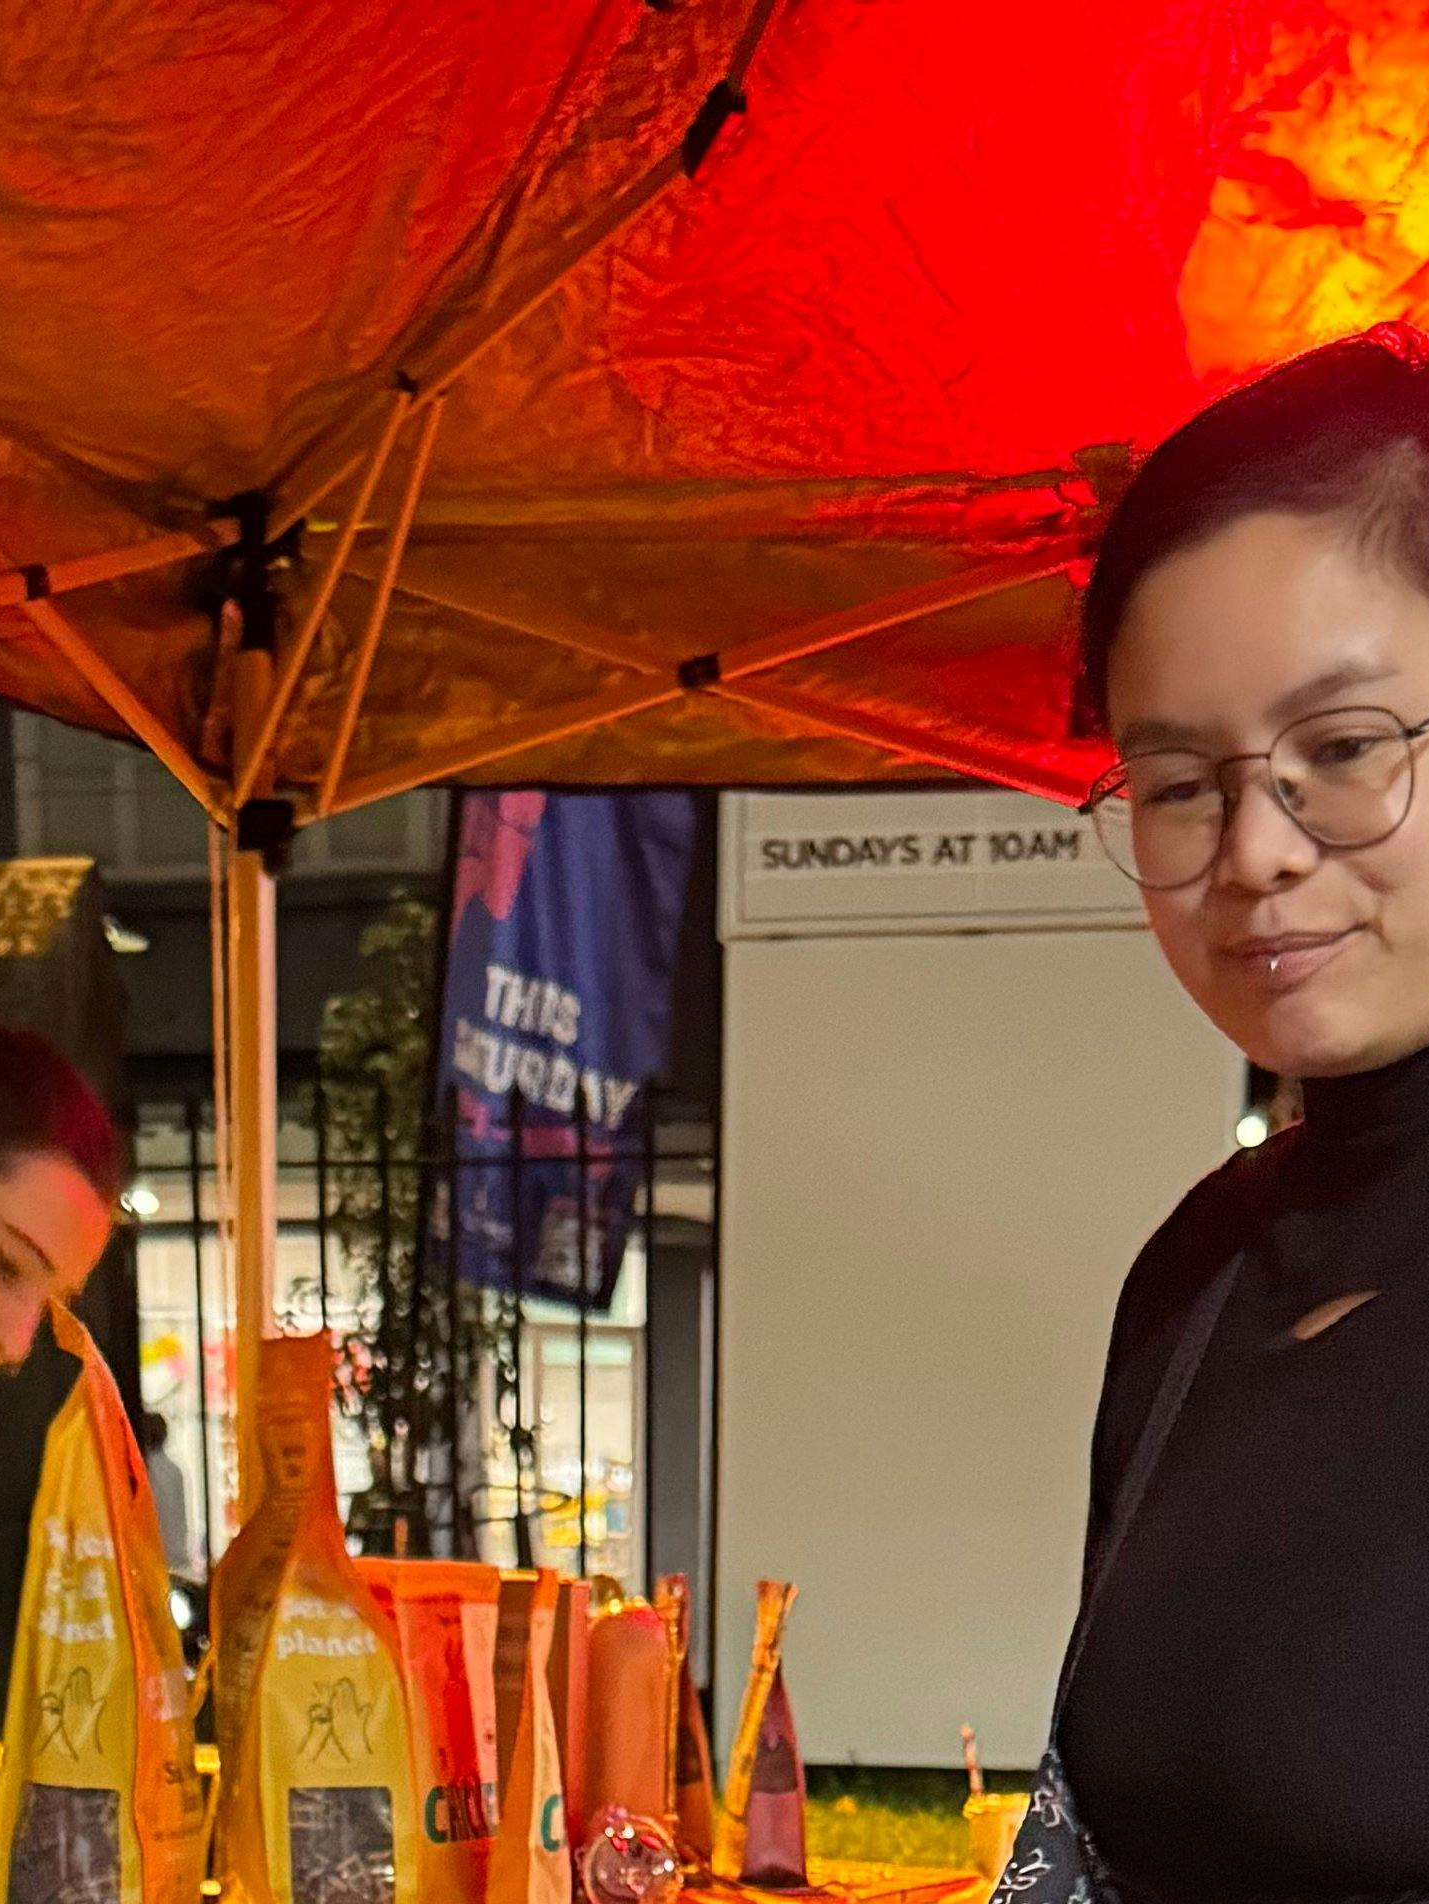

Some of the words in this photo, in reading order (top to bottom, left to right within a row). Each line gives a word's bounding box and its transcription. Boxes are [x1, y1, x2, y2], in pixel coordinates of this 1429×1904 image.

[762, 835, 922, 870] SUNDAYS
[934, 834, 977, 865] AT
[988, 831, 1081, 863] 10AM
[484, 965, 582, 1046] THIS
